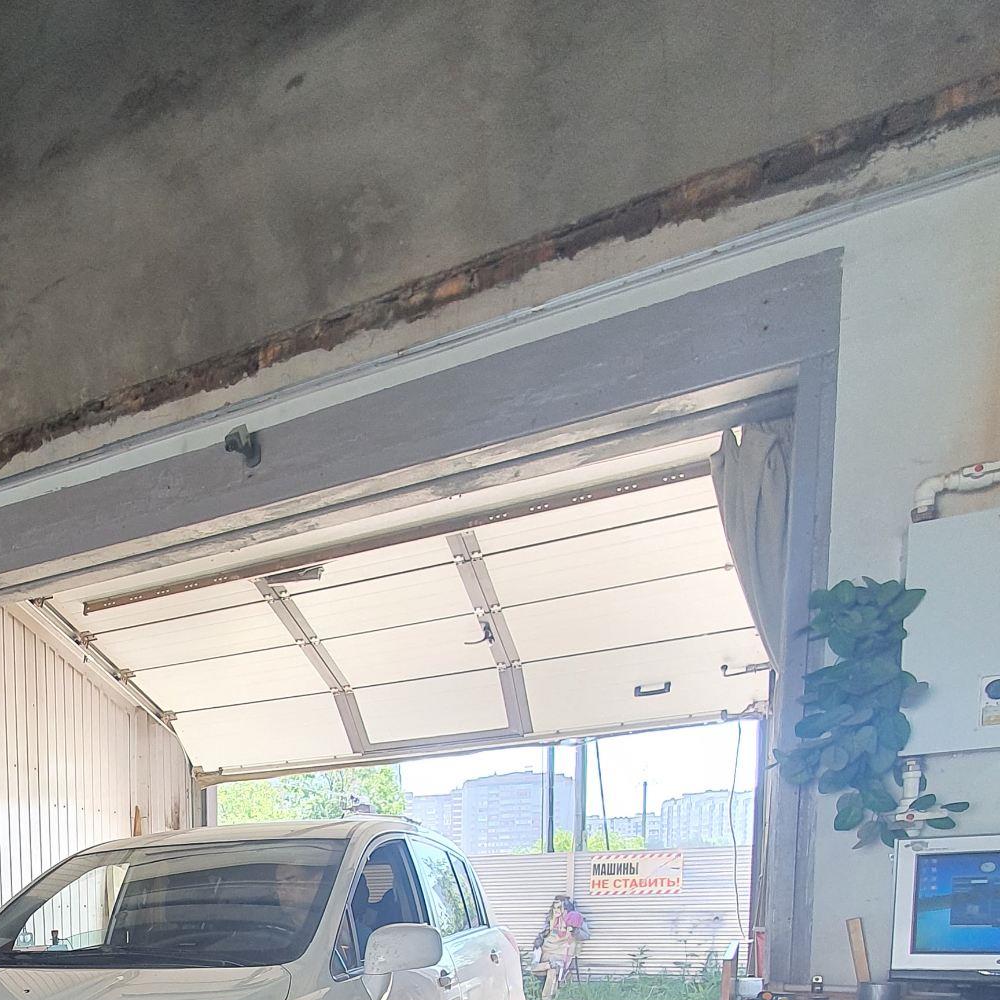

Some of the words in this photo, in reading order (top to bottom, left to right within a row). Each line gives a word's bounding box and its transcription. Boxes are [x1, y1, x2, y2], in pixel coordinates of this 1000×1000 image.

[592, 862, 639, 876] МАШИНЫ
[591, 879, 609, 889] НЕ
[613, 877, 680, 889] СТАВИТЬ!
